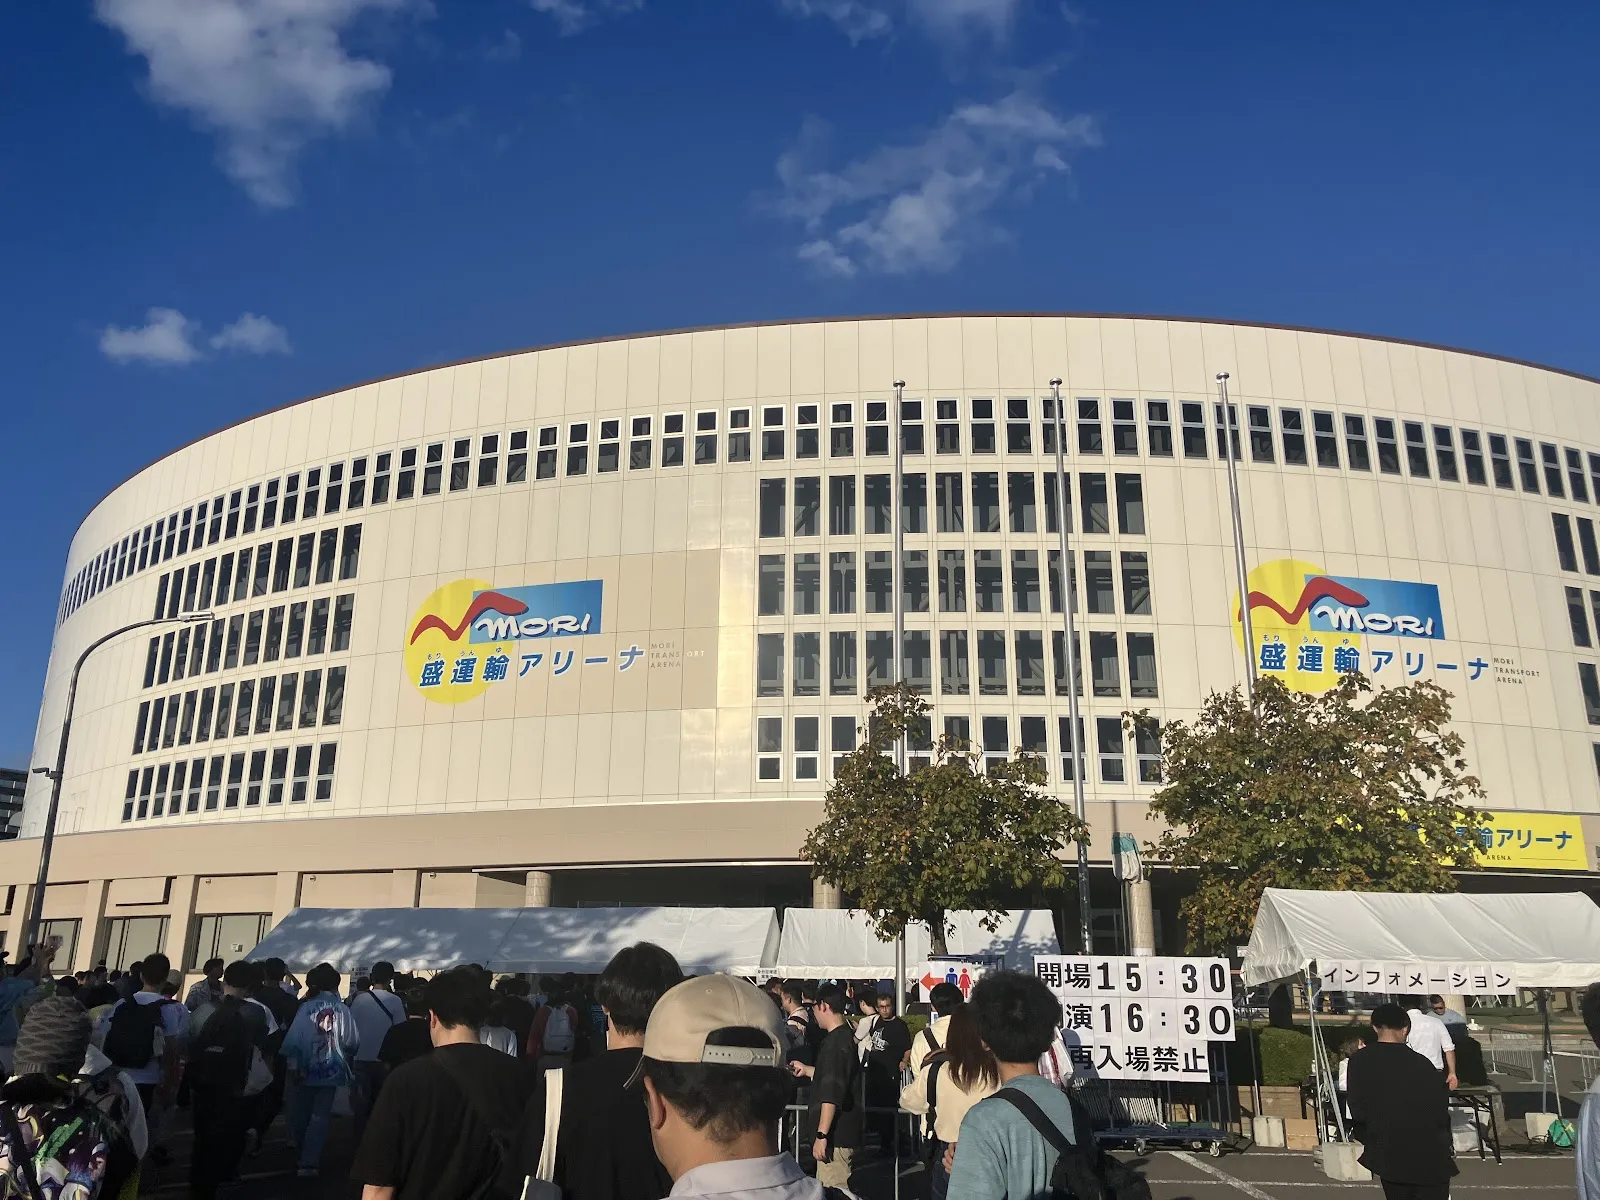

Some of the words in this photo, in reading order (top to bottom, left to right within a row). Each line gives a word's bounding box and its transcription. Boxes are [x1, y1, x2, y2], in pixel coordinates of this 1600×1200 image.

[475, 613, 592, 641] MORI
[1314, 605, 1436, 638] MORI
[650, 650, 705, 659] TRANSORT
[651, 641, 675, 650] MORI
[419, 645, 645, 687] 盛運輸アリーナ
[650, 661, 681, 669] ARENA
[1259, 643, 1489, 681] 盛運輸アリーナ
[1493, 657, 1514, 665] MORI
[1494, 666, 1540, 677] TRANSPORT
[1496, 676, 1523, 685] ARENA
[1324, 968, 1511, 988] インフォメーション
[1059, 1003, 1232, 1035] 演16:30
[1067, 1045, 1208, 1074] 再入場禁止
